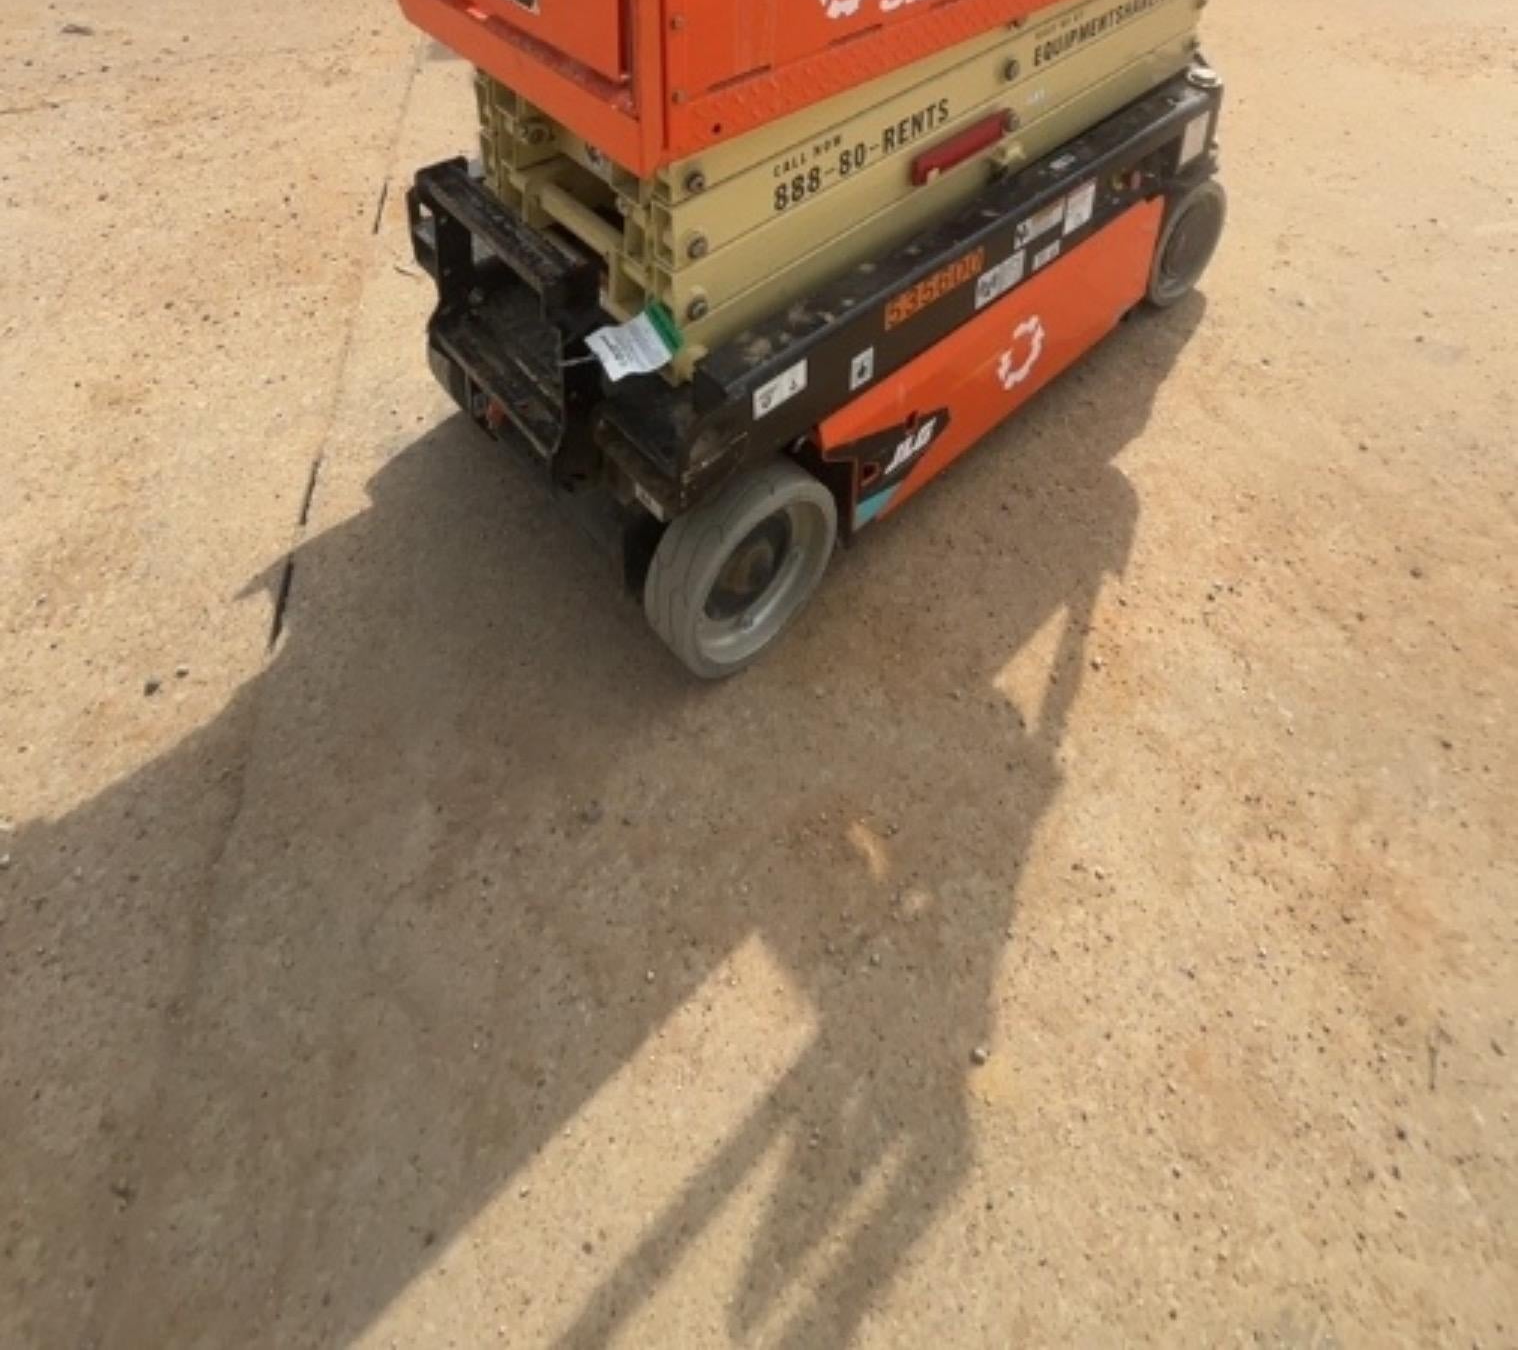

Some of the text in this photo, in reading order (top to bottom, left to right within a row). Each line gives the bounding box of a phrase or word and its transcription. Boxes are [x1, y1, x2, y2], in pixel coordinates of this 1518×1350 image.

[773, 97, 949, 212] 888-80-RENTS
[773, 134, 842, 178] CALL NOW
